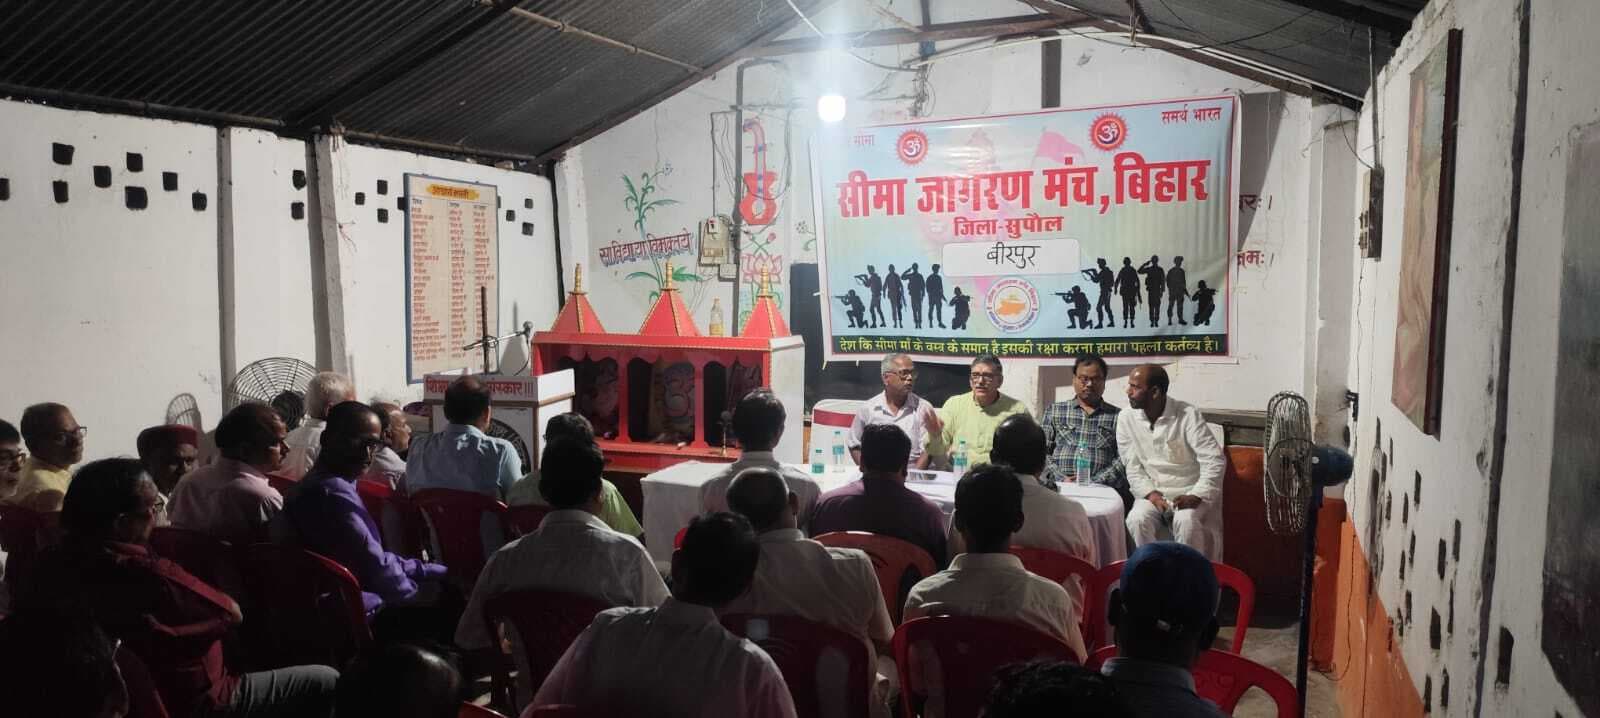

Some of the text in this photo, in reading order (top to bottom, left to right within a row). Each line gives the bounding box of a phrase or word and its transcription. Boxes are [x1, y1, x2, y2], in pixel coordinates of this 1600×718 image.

[1161, 104, 1222, 123] समर्थ भारत
[835, 170, 908, 218] सीमा
[915, 170, 1034, 214] जागरण
[1114, 151, 1211, 205] बिहार
[839, 338, 856, 352] देश
[859, 337, 872, 351] कि
[876, 338, 896, 351] सीमा
[914, 338, 924, 352] के
[947, 338, 958, 353] के
[961, 341, 988, 353] समान
[991, 338, 999, 355] है
[1002, 338, 1033, 354] इसकी
[1037, 342, 1059, 354] रक्षा
[1062, 342, 1092, 354] करना
[1097, 341, 1128, 356] हमारा
[1131, 340, 1161, 354] पहला
[1165, 336, 1200, 352] कर्तव्य
